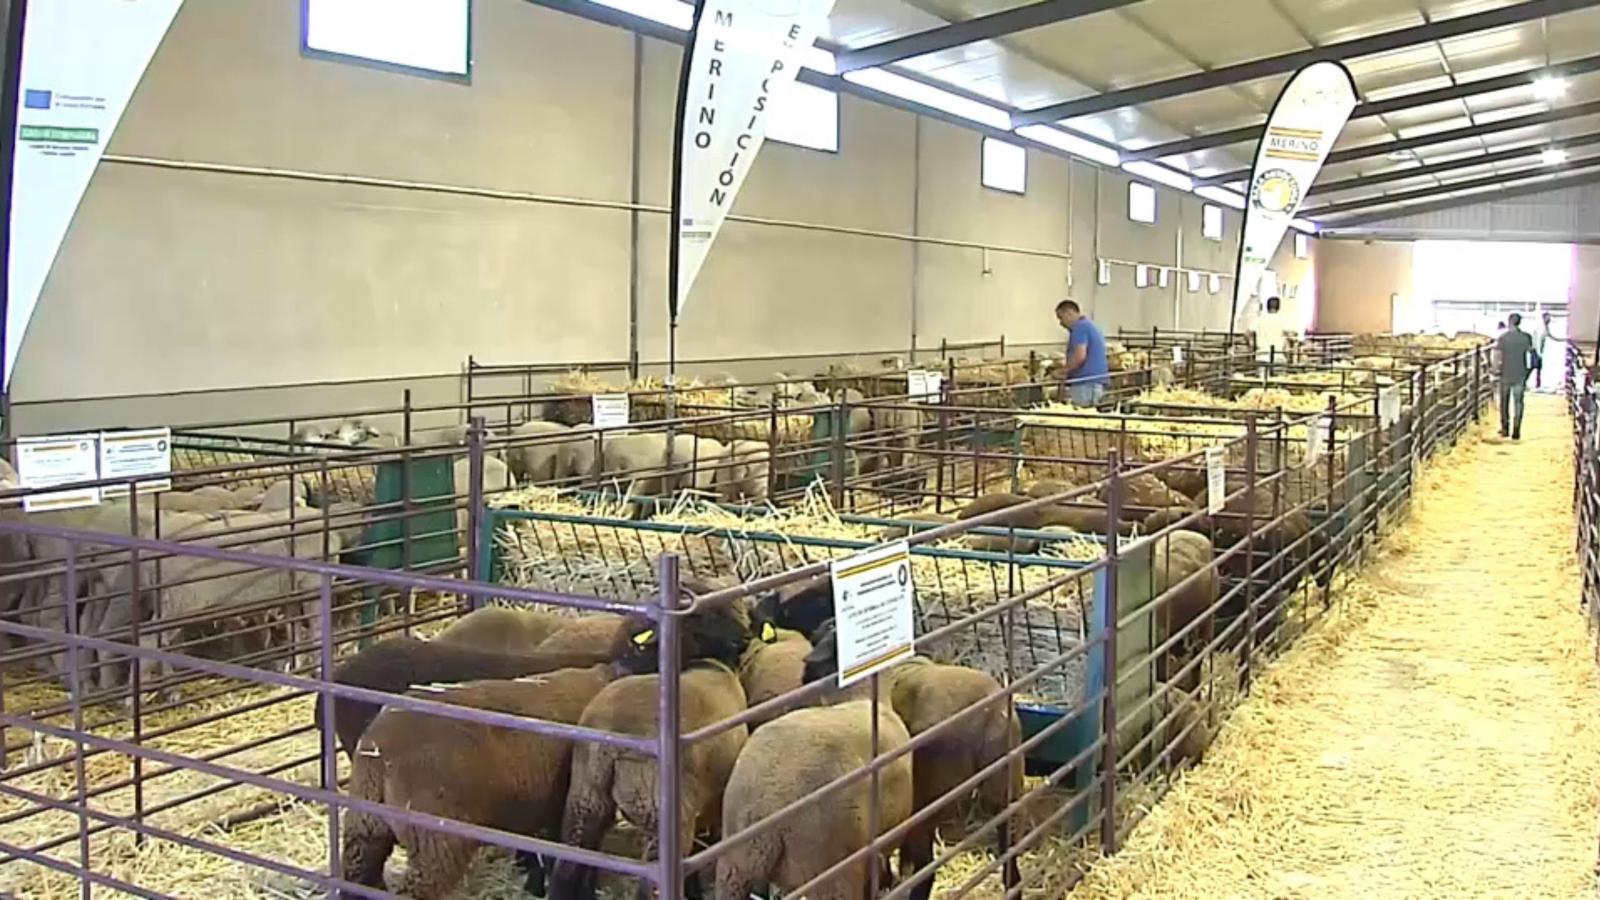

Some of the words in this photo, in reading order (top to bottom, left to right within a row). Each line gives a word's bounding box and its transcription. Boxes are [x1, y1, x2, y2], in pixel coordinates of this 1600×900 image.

[695, 9, 733, 149] MERINO
[709, 23, 802, 207] EPSICIÓN
[1270, 137, 1319, 151] MERINO
